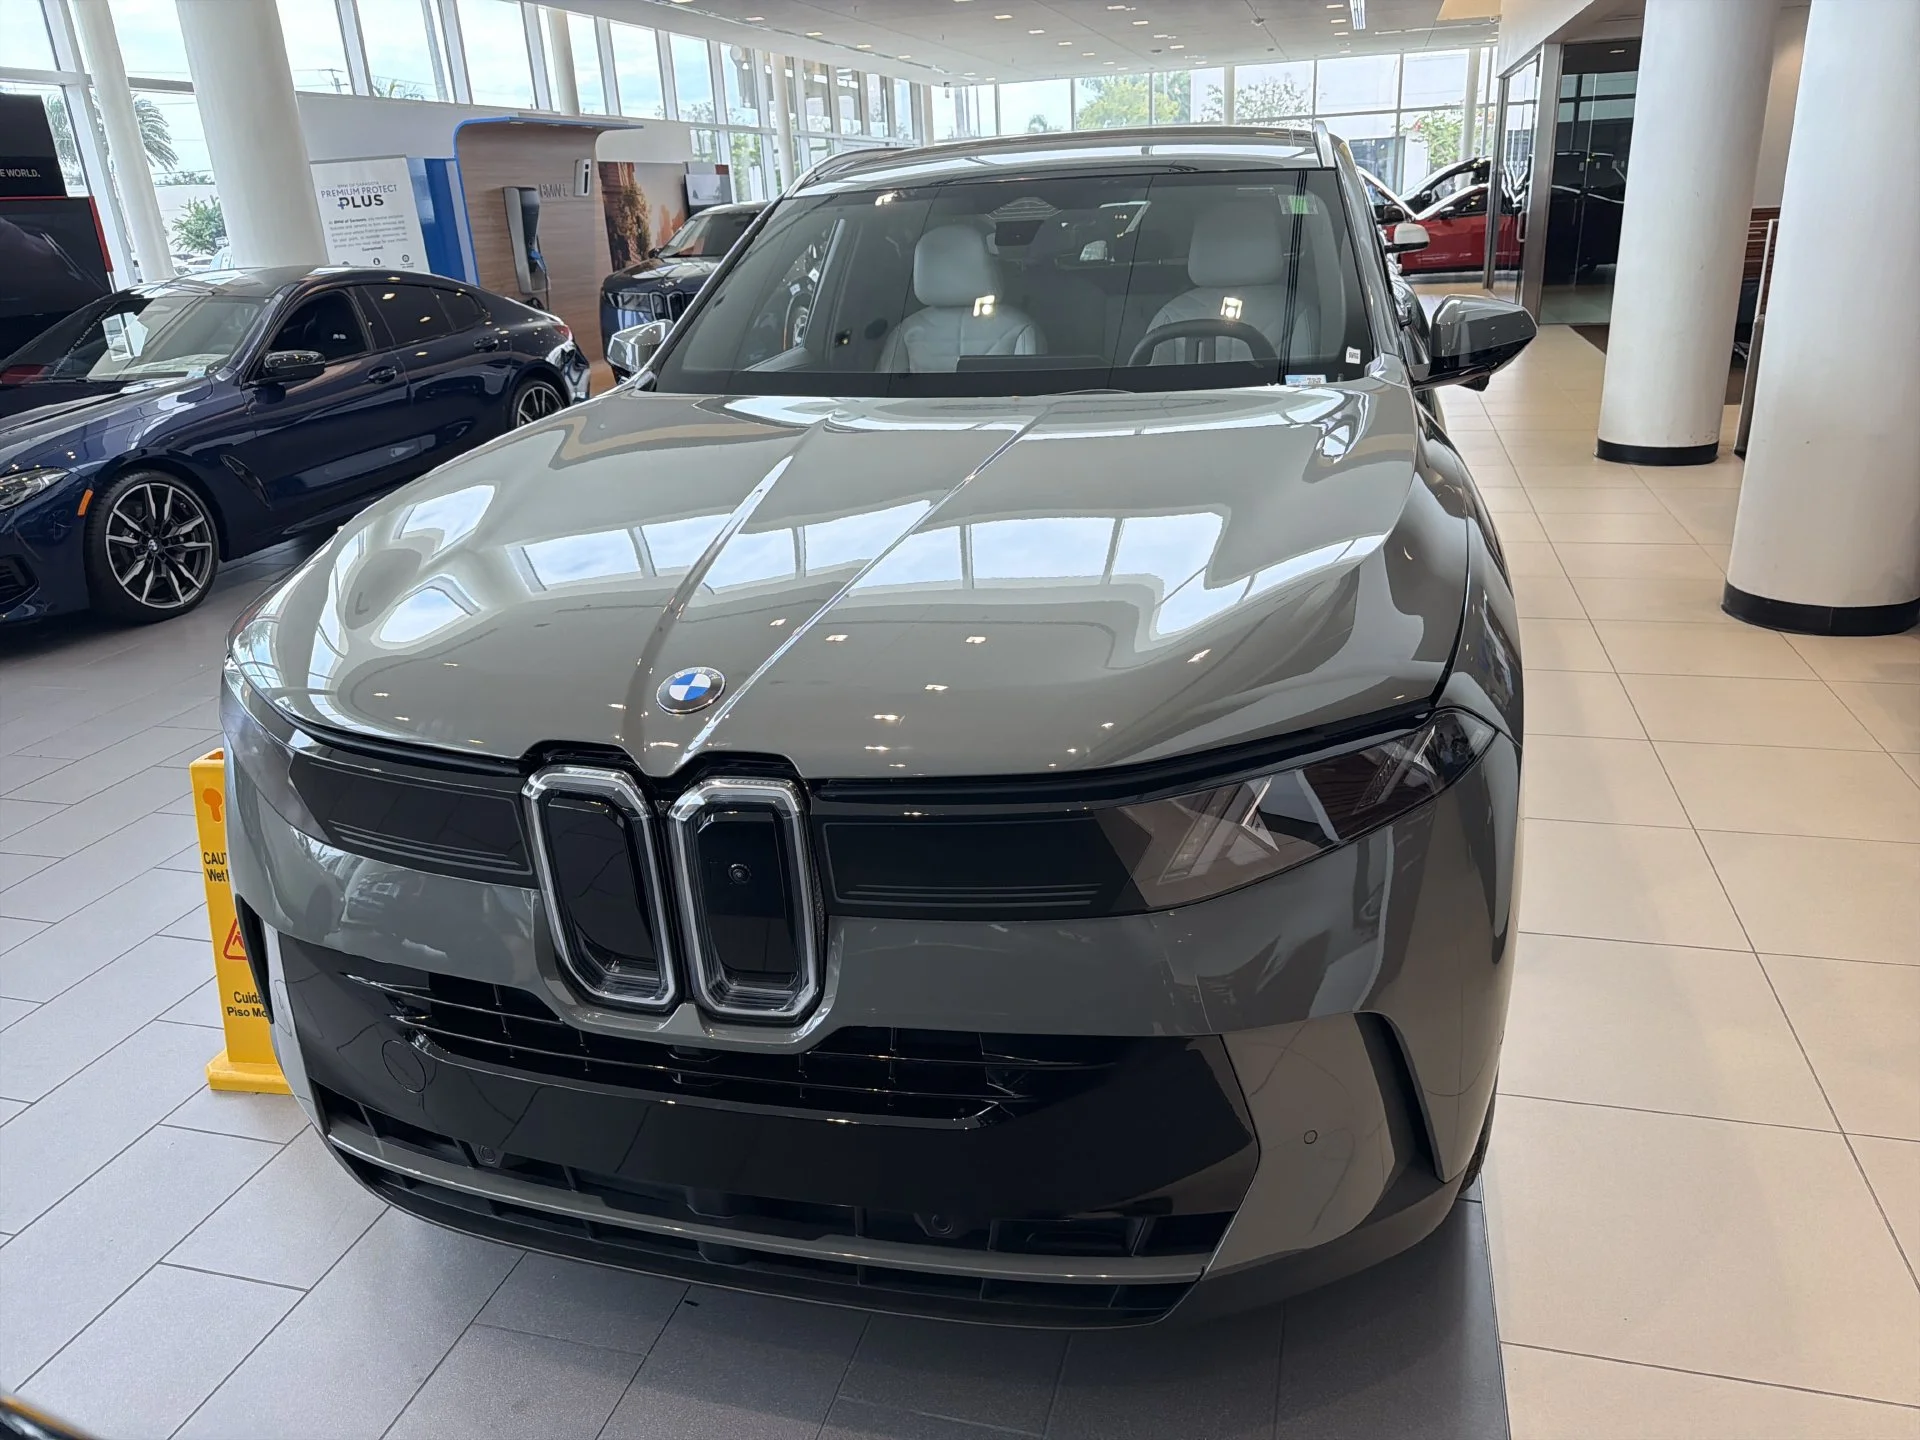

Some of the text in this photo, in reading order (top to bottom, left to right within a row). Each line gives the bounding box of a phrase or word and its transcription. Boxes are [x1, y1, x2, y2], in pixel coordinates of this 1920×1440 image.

[6, 168, 41, 178] WORLD.
[320, 184, 397, 198] PREMIUM PROTECT
[338, 194, 384, 210] PLUS
[206, 869, 226, 882] Wet
[226, 1006, 250, 1017] Piso
